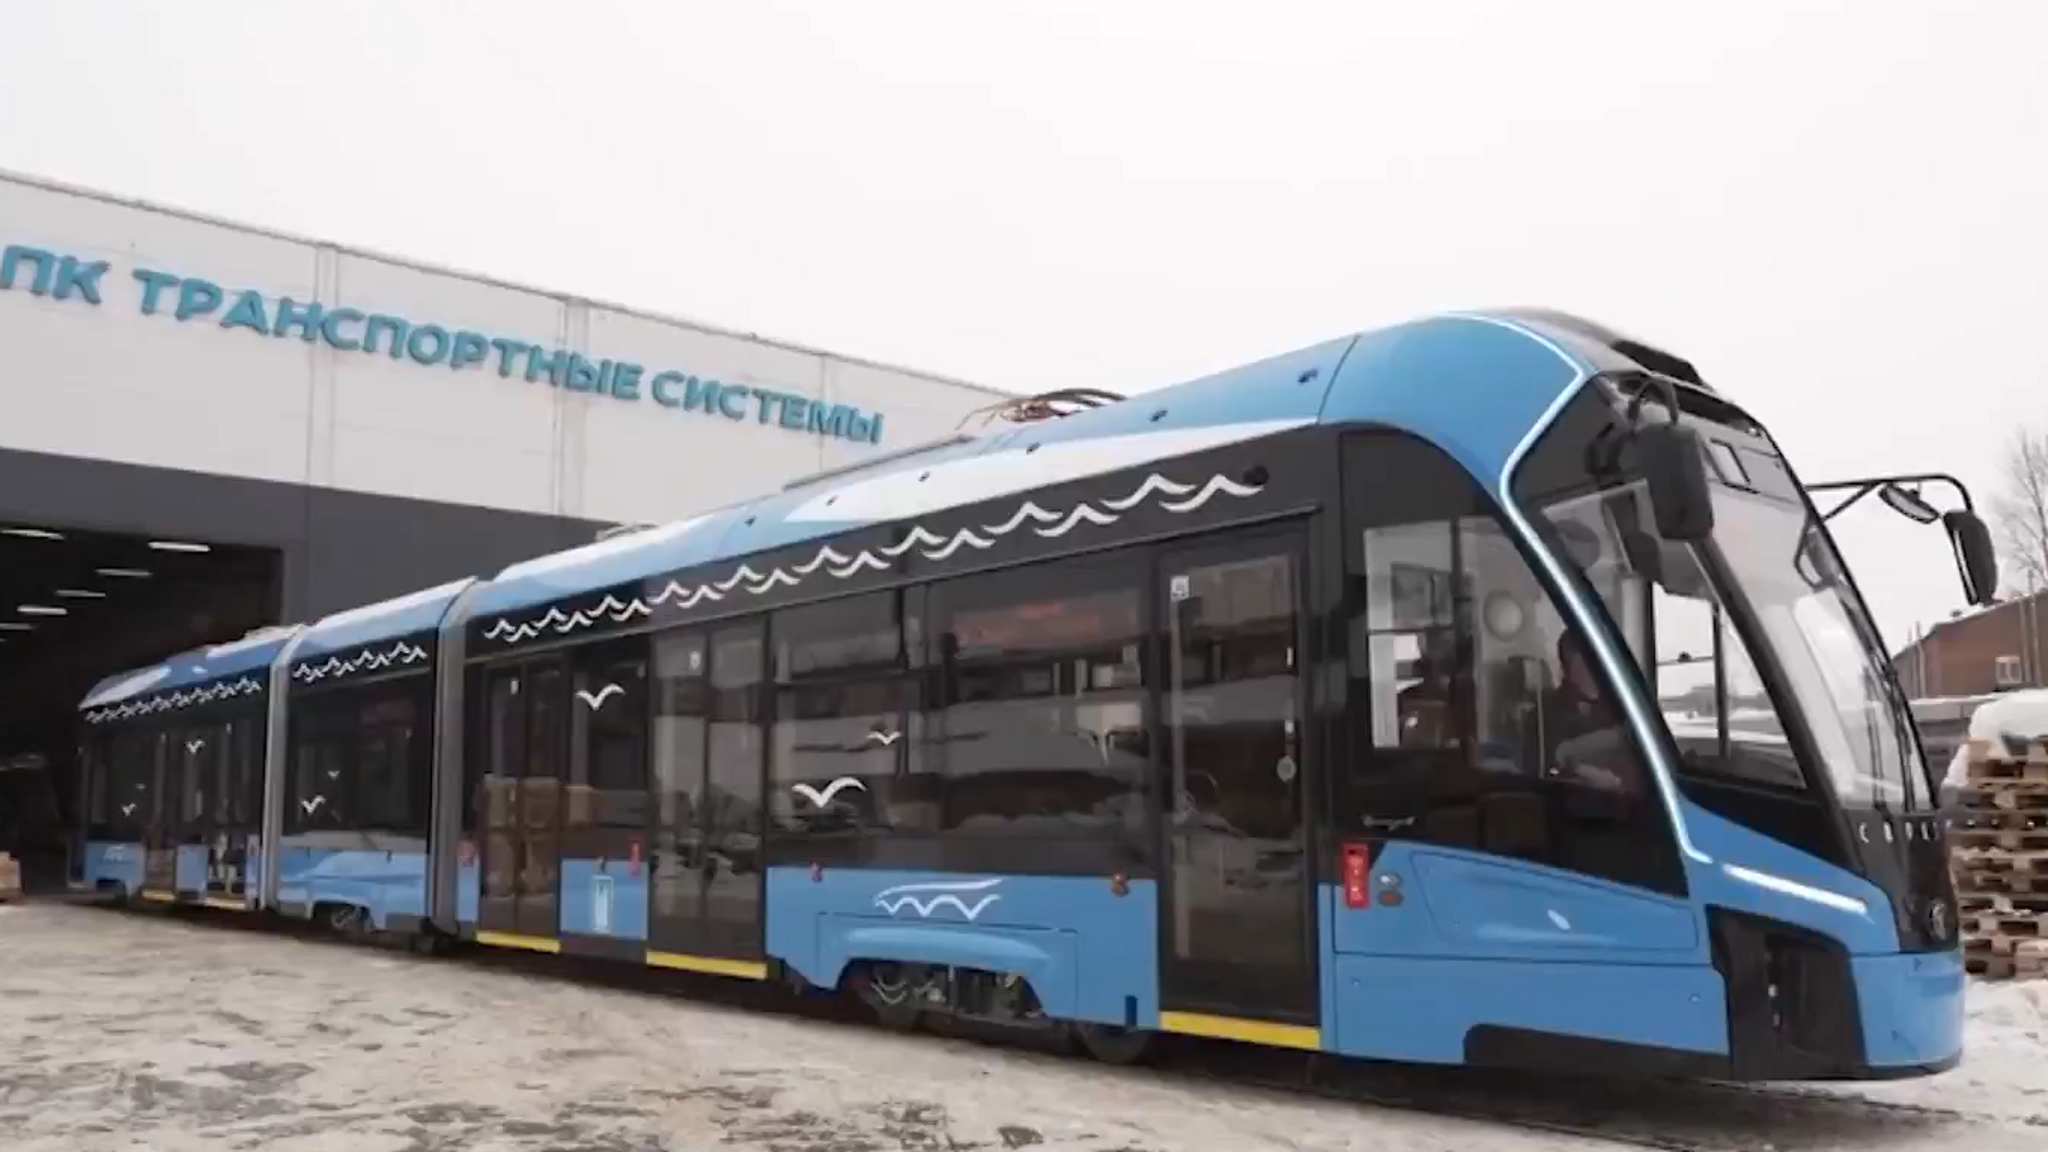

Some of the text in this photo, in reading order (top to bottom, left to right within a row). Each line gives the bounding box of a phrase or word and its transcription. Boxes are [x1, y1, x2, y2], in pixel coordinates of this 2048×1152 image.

[0, 245, 884, 445] ПК ТРАНСПОРТНЫЕ СИСТЕМЫ
